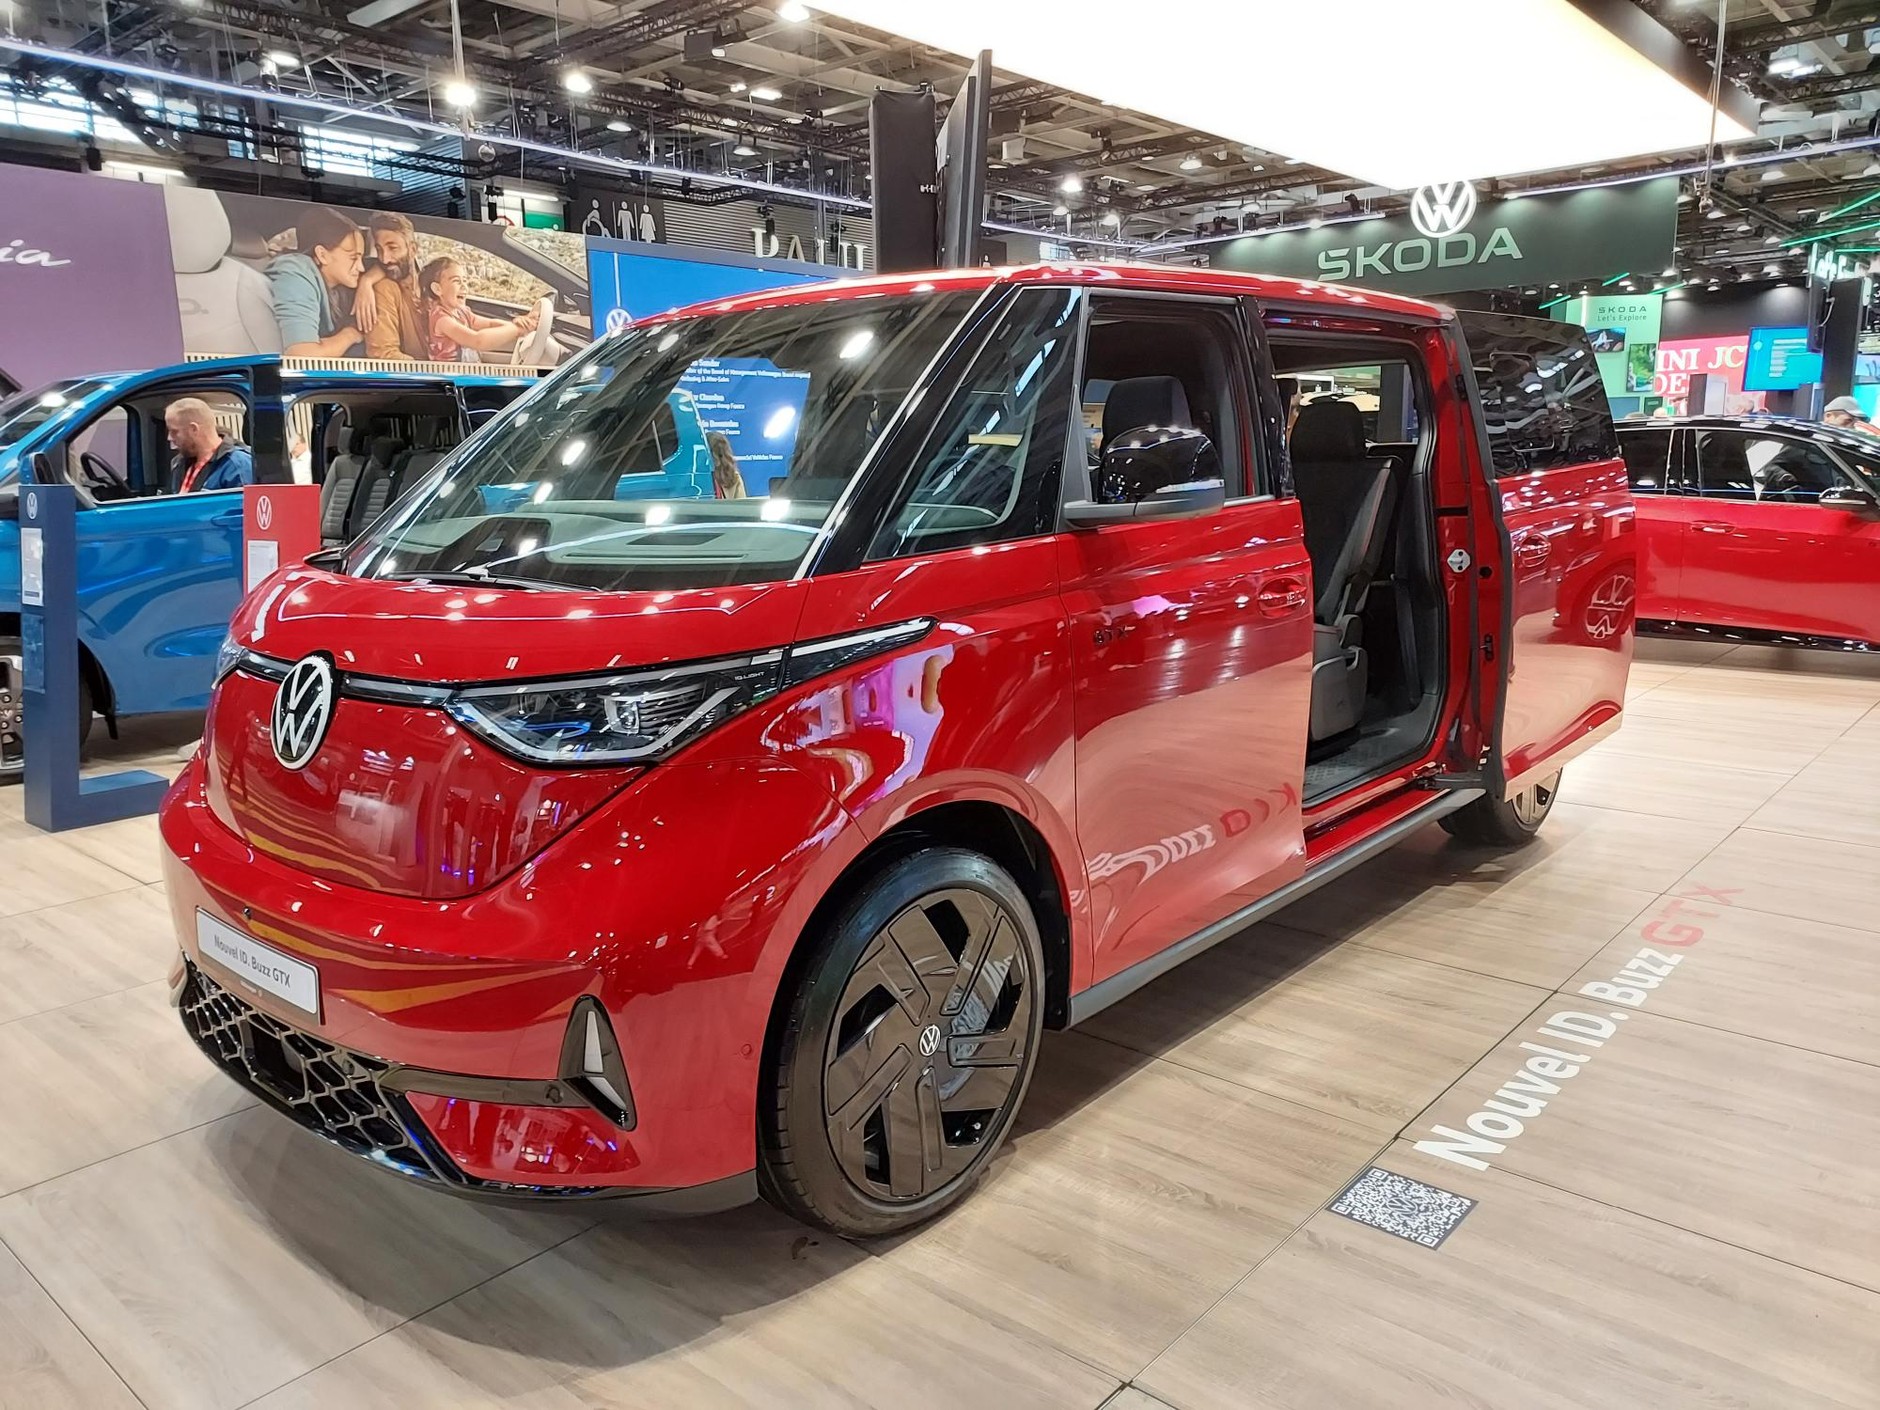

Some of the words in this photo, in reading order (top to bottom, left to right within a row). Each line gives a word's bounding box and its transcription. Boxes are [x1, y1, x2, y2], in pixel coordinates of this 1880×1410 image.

[1619, 313, 1647, 323] Explore
[1640, 884, 1746, 948] GTX
[214, 934, 238, 959] Nouvel
[239, 949, 251, 968] ID.
[251, 956, 272, 978] Buzz
[272, 967, 291, 989] GTX
[1577, 947, 1685, 1007] Buzz
[1536, 1010, 1630, 1048] ID.
[1412, 1040, 1593, 1172] Nouvel
